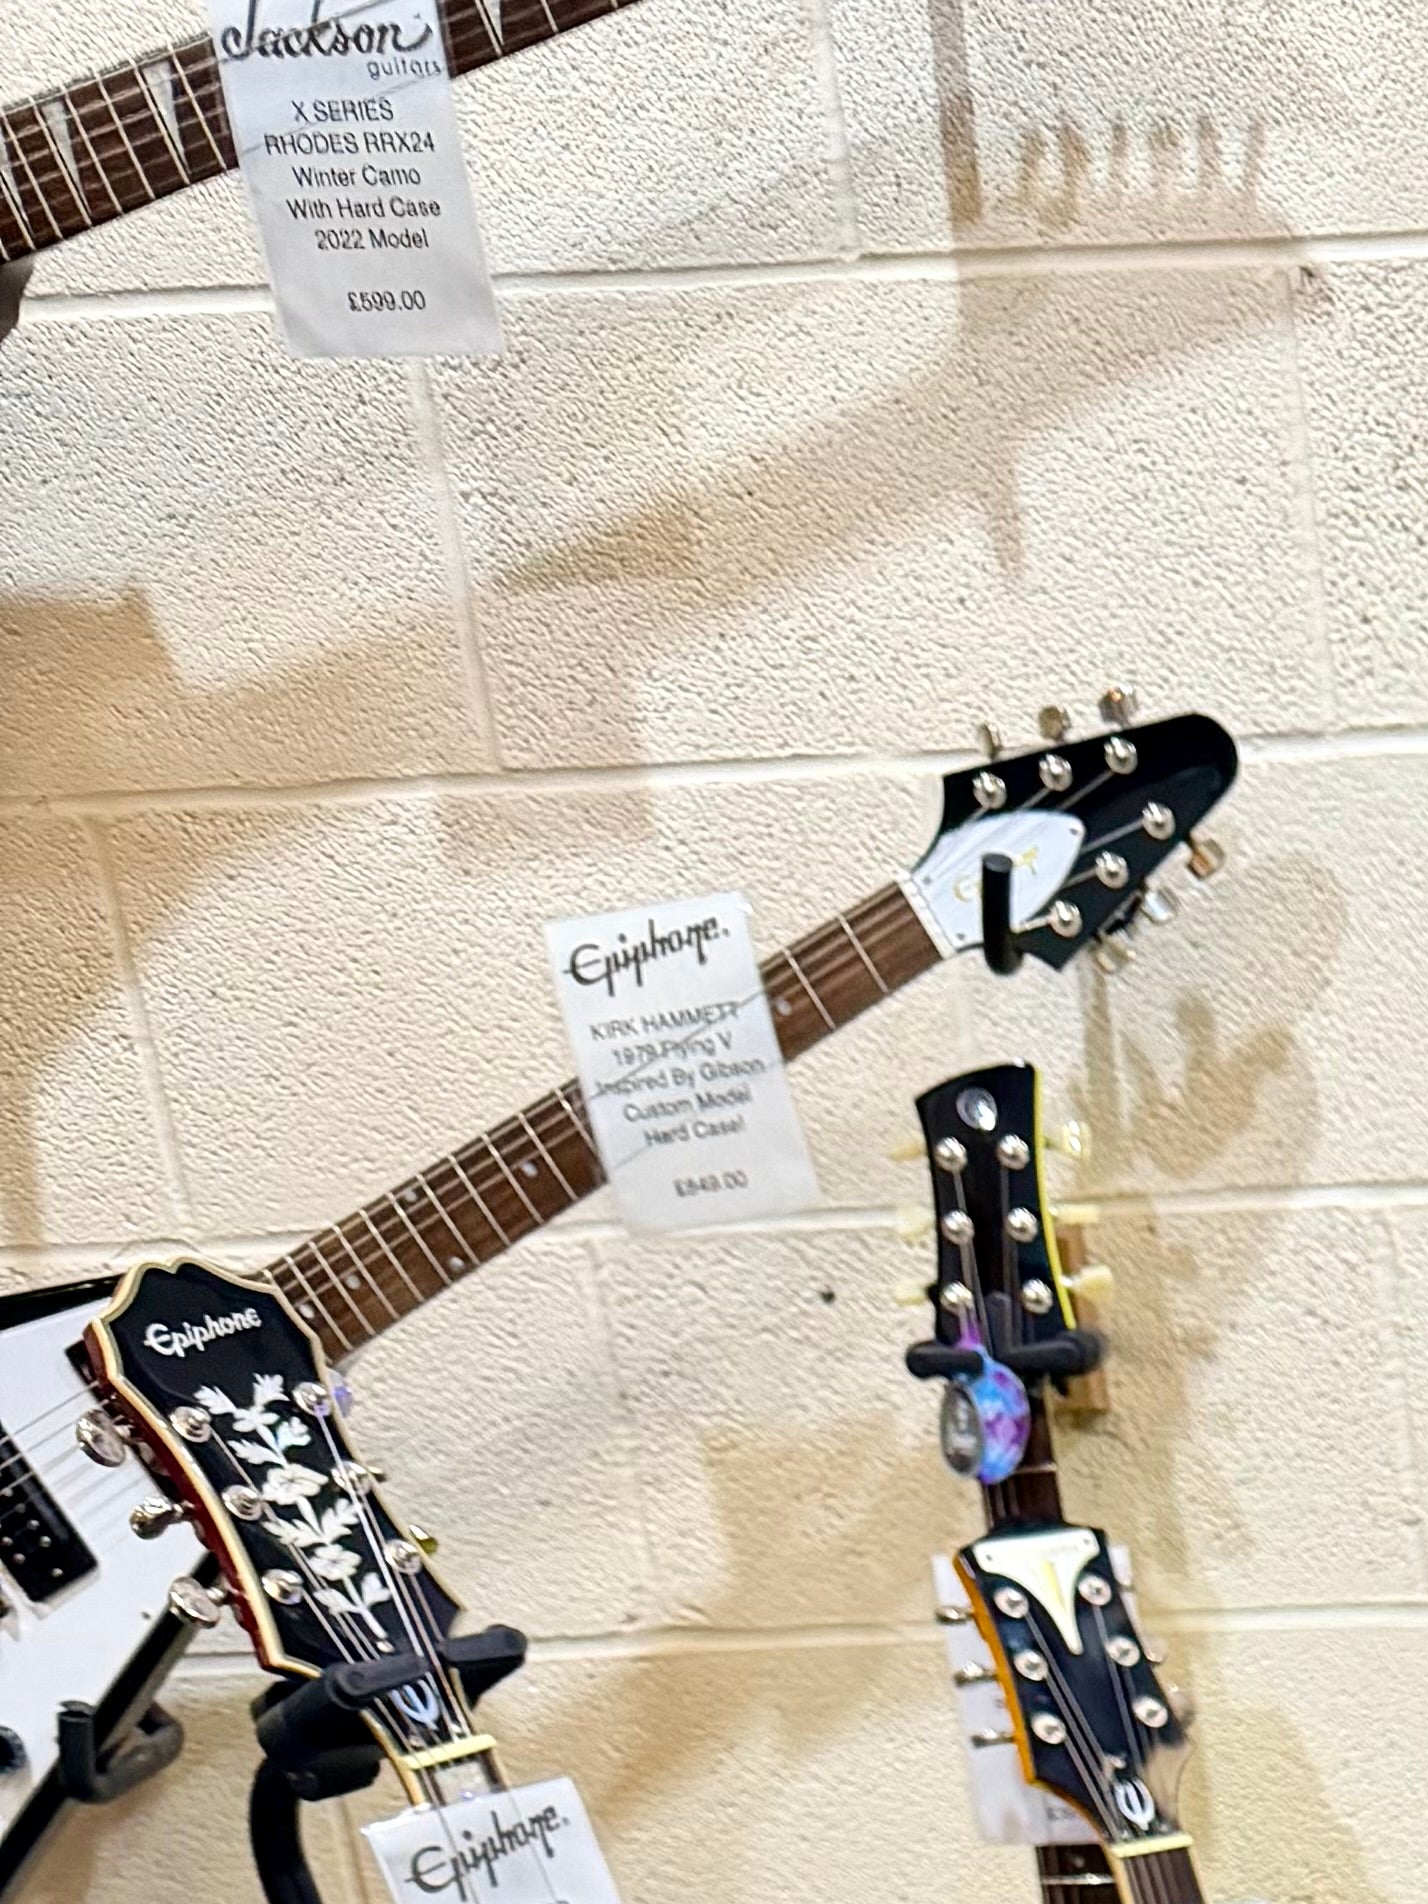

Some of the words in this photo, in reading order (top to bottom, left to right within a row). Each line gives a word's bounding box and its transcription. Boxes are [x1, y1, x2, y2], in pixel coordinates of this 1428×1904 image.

[222, 0, 433, 58] Jackson
[366, 57, 442, 80] guitars
[291, 99, 310, 124] X
[312, 96, 394, 122] SERIES
[263, 132, 360, 156] RHODES
[364, 131, 436, 154] RRX24
[291, 166, 356, 188] Winter
[361, 164, 422, 187] Camo
[285, 197, 333, 220] With
[337, 197, 386, 218] Hard
[390, 197, 442, 217] Case
[314, 229, 366, 251] 2022
[369, 228, 430, 250] Model
[347, 290, 427, 312] £599.00
[589, 1015, 639, 1041] KIRK
[718, 1030, 733, 1051] V
[671, 1065, 697, 1090] By
[700, 1056, 766, 1082] Gibson
[622, 1096, 694, 1124] Custom
[694, 1083, 754, 1109] Model
[643, 1122, 690, 1147] Hard
[143, 1307, 263, 1358] Epiphone
